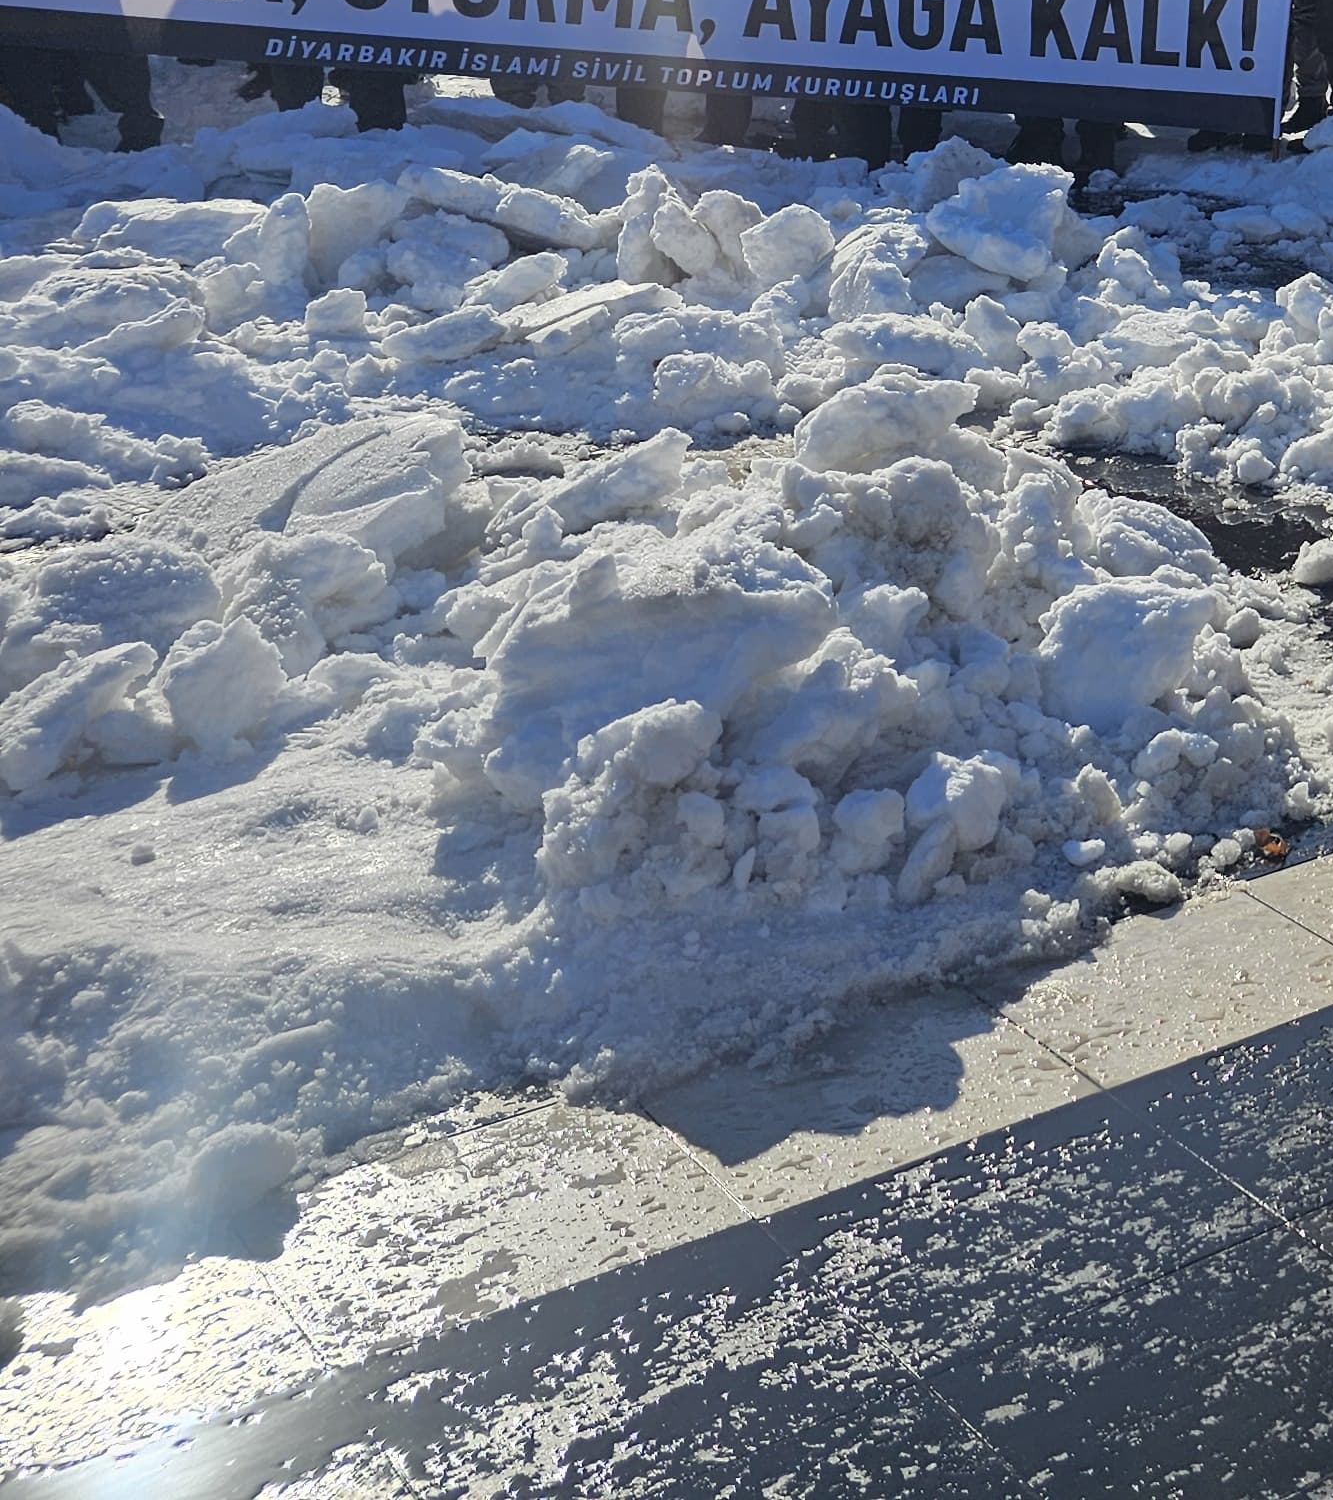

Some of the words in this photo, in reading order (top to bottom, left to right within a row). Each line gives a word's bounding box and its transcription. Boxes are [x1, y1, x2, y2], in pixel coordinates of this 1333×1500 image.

[264, 34, 448, 71] DİYARBAKIR
[459, 46, 563, 80] İSLAMİ
[571, 55, 648, 84] SİVİL
[660, 65, 773, 95] TOPLUM
[784, 73, 981, 108] KURULUŞLARI
